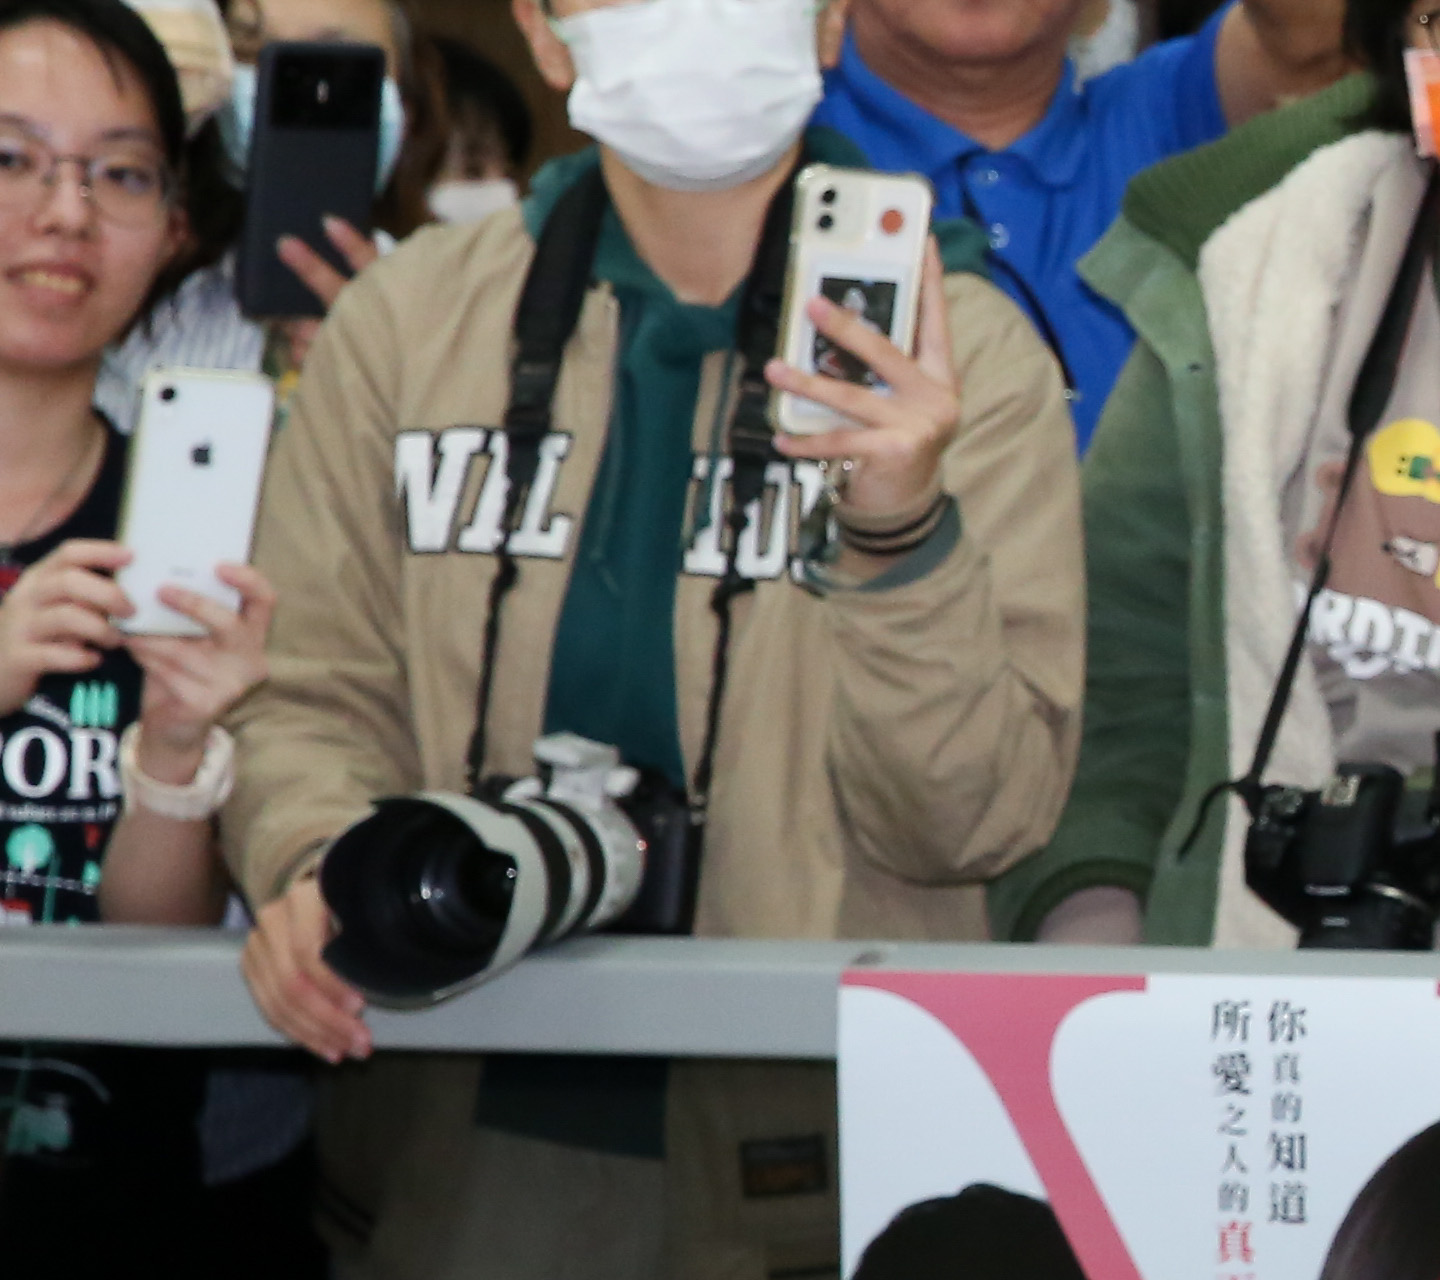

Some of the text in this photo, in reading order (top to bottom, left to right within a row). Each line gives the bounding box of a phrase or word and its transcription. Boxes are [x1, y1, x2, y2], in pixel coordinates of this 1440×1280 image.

[1266, 998, 1309, 1225] 你真的知道
